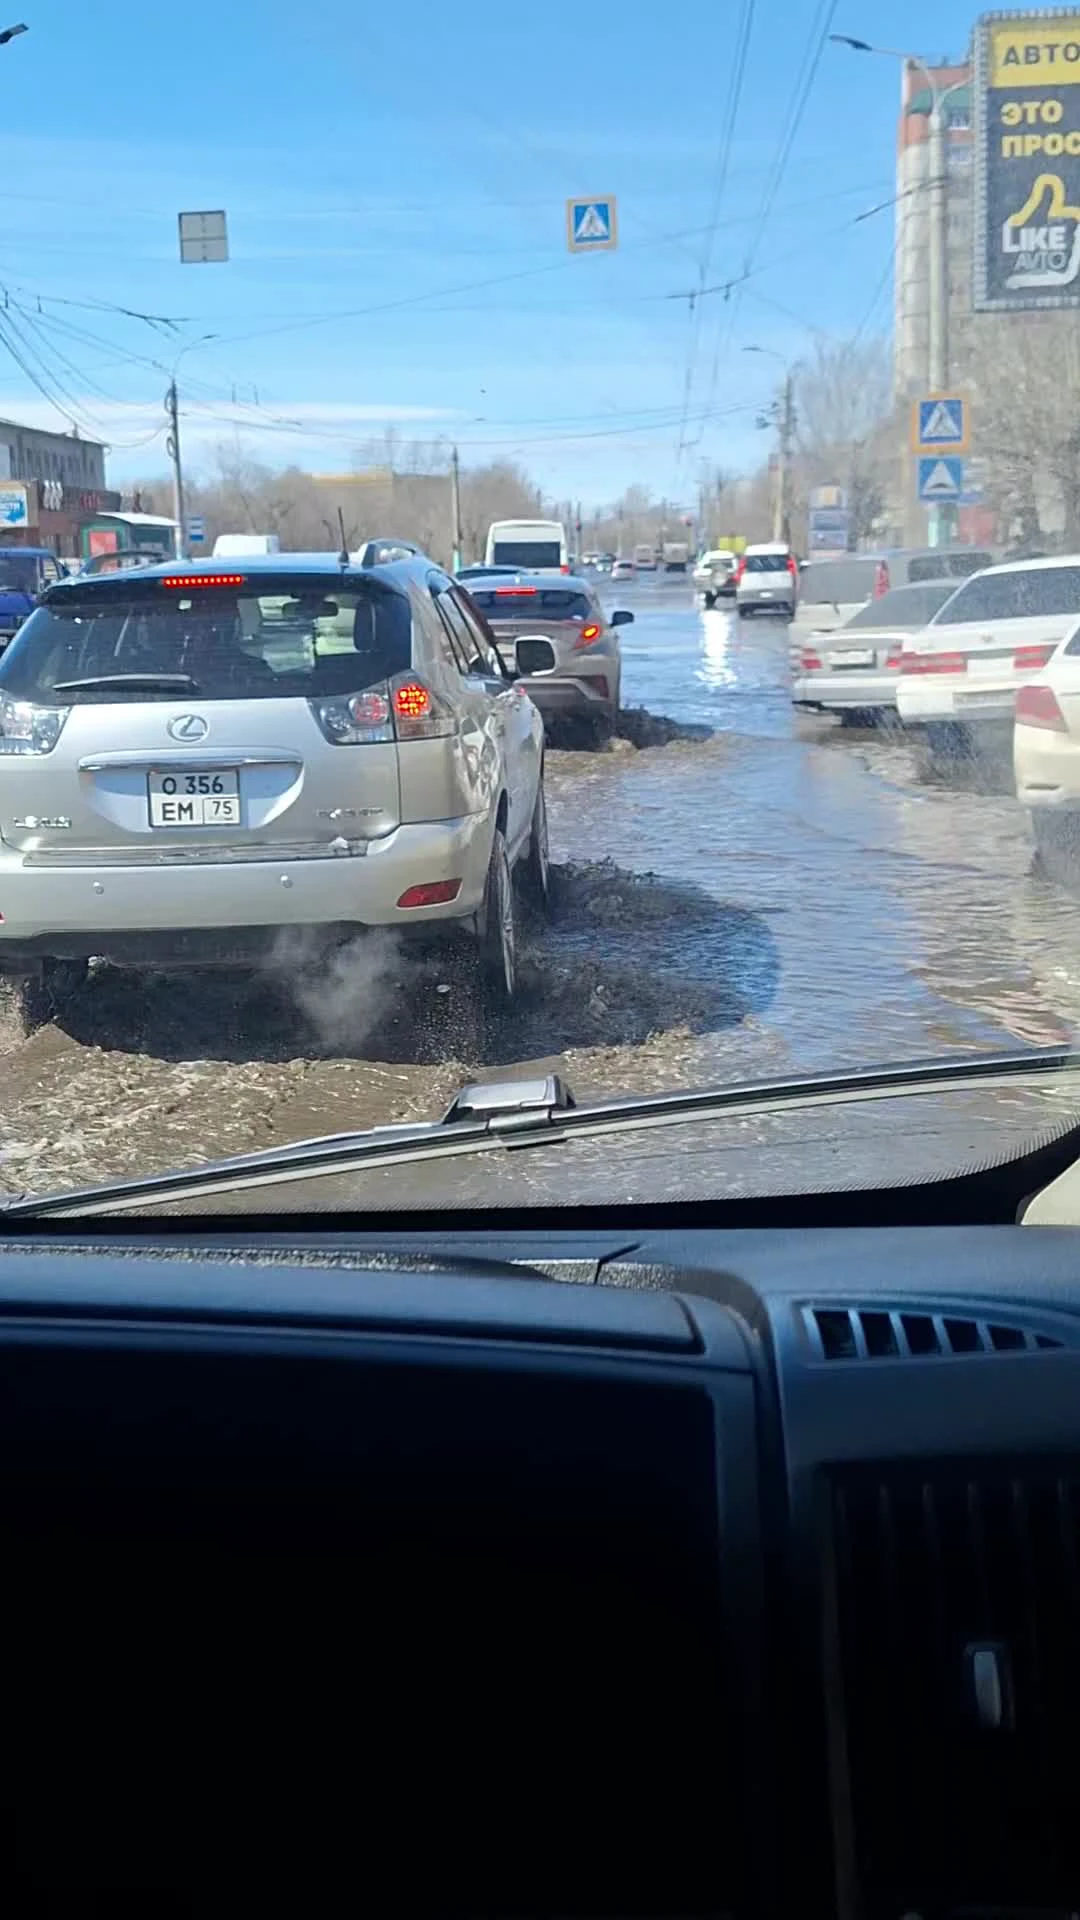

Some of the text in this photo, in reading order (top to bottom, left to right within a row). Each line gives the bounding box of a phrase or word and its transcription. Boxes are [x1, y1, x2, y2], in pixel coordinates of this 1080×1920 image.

[1003, 42, 1080, 66] АВТО
[1001, 100, 1063, 126] ЭТО
[1002, 132, 1080, 158] ПРОС
[1002, 224, 1067, 253] LIKE
[185, 776, 224, 794] 356
[162, 801, 232, 821] ЕМ 75
